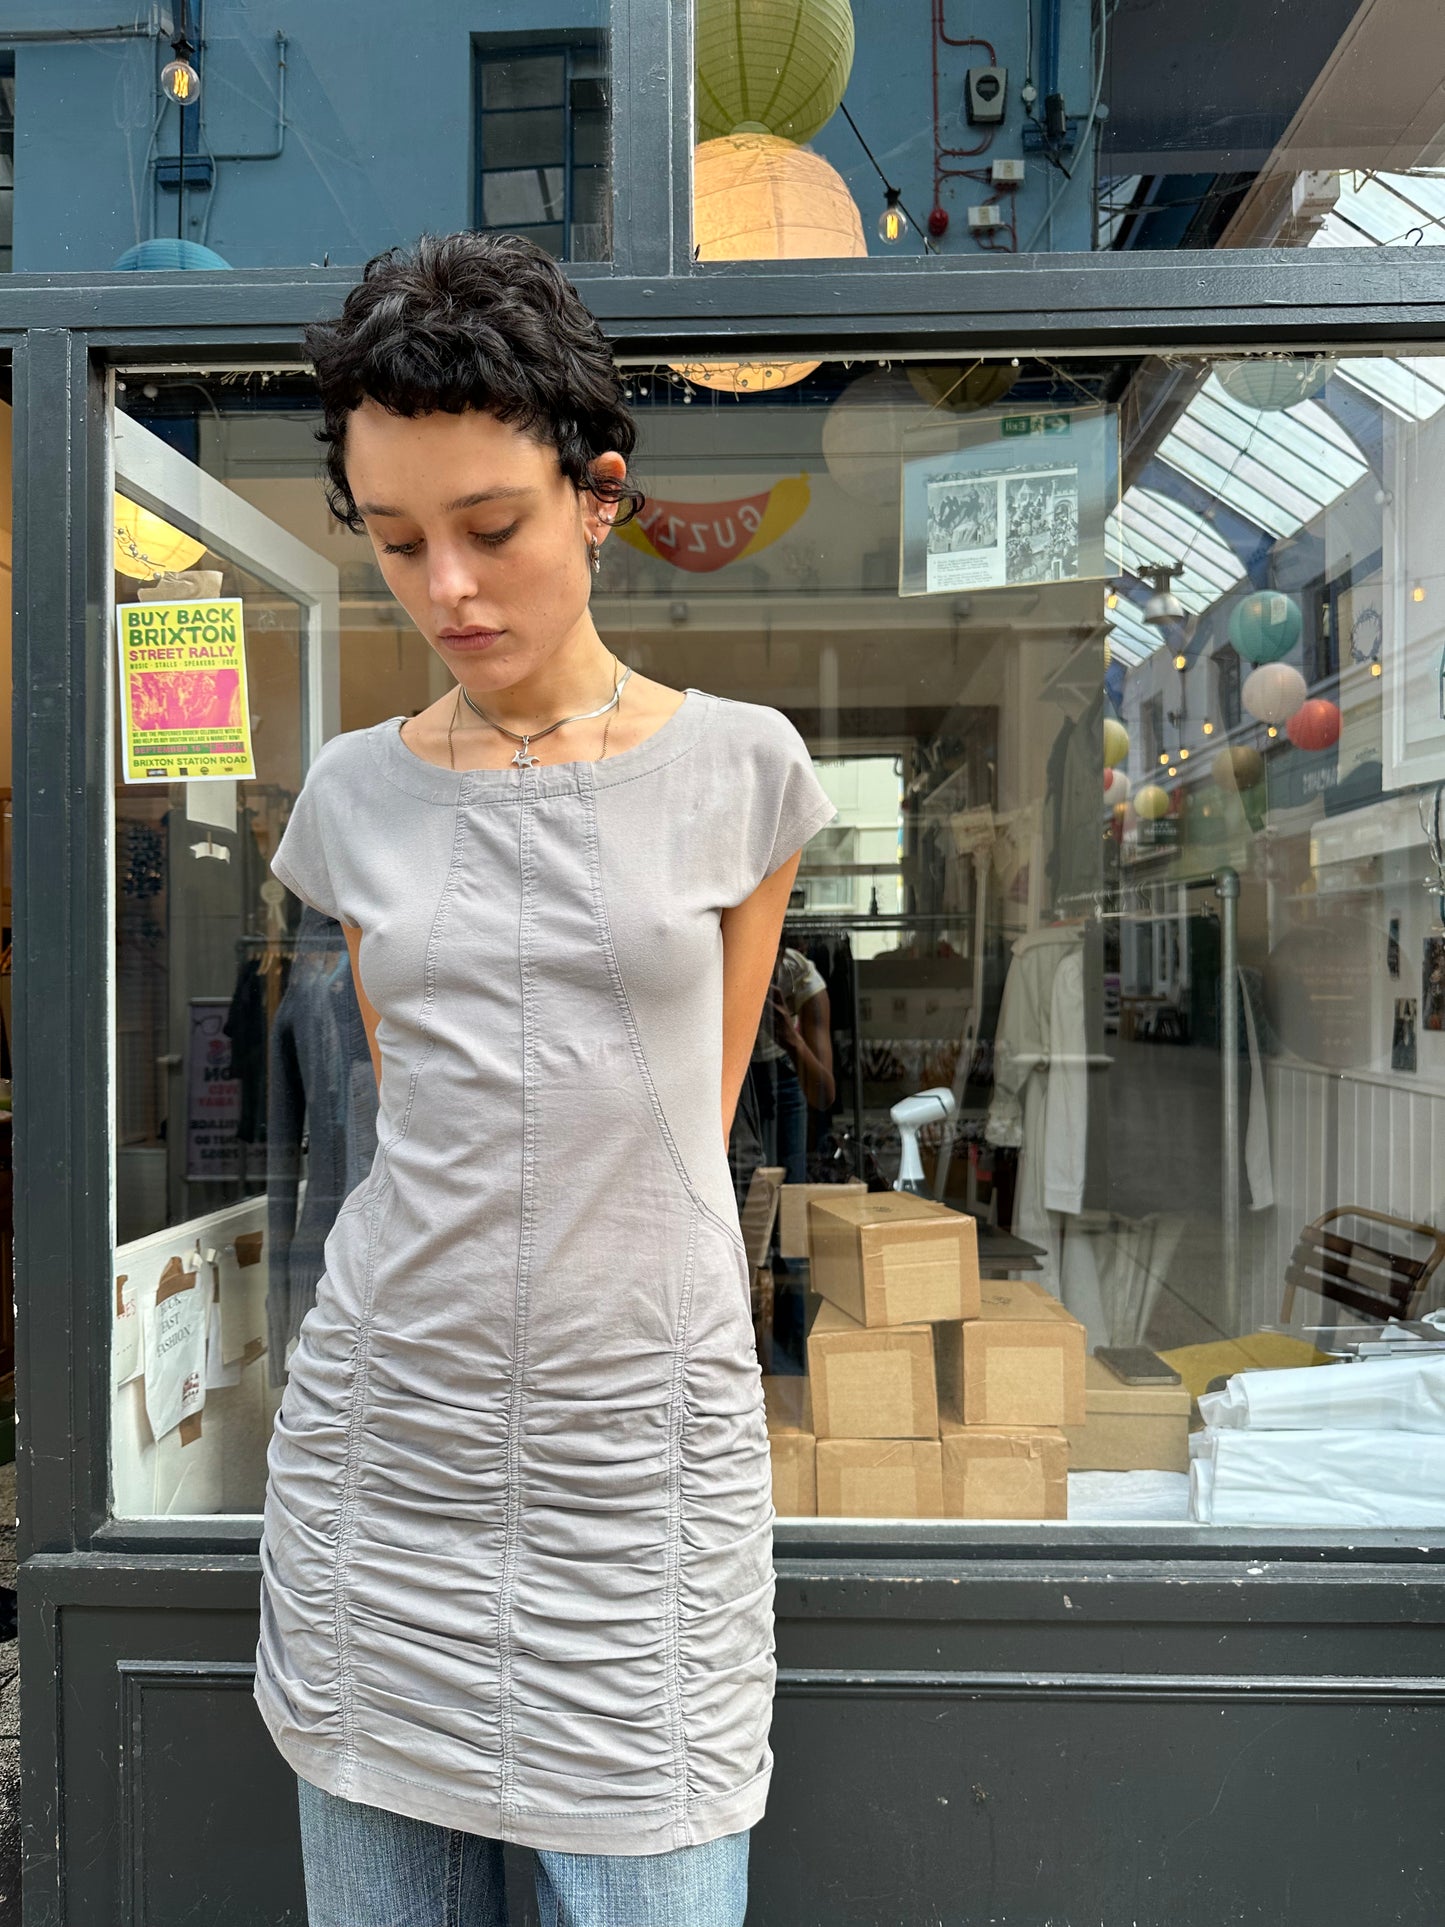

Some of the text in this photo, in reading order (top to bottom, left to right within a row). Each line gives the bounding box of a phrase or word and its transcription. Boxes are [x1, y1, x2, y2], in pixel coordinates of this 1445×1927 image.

[128, 608, 234, 627] BUY BACK
[129, 625, 236, 646] BRIXTON
[129, 646, 235, 661] STREET RALLY
[135, 746, 188, 754] SEPTEMBER
[133, 755, 247, 767] BRIXTON STATION ROAD
[161, 1311, 180, 1334] FAST
[156, 1323, 191, 1358] FASHION
